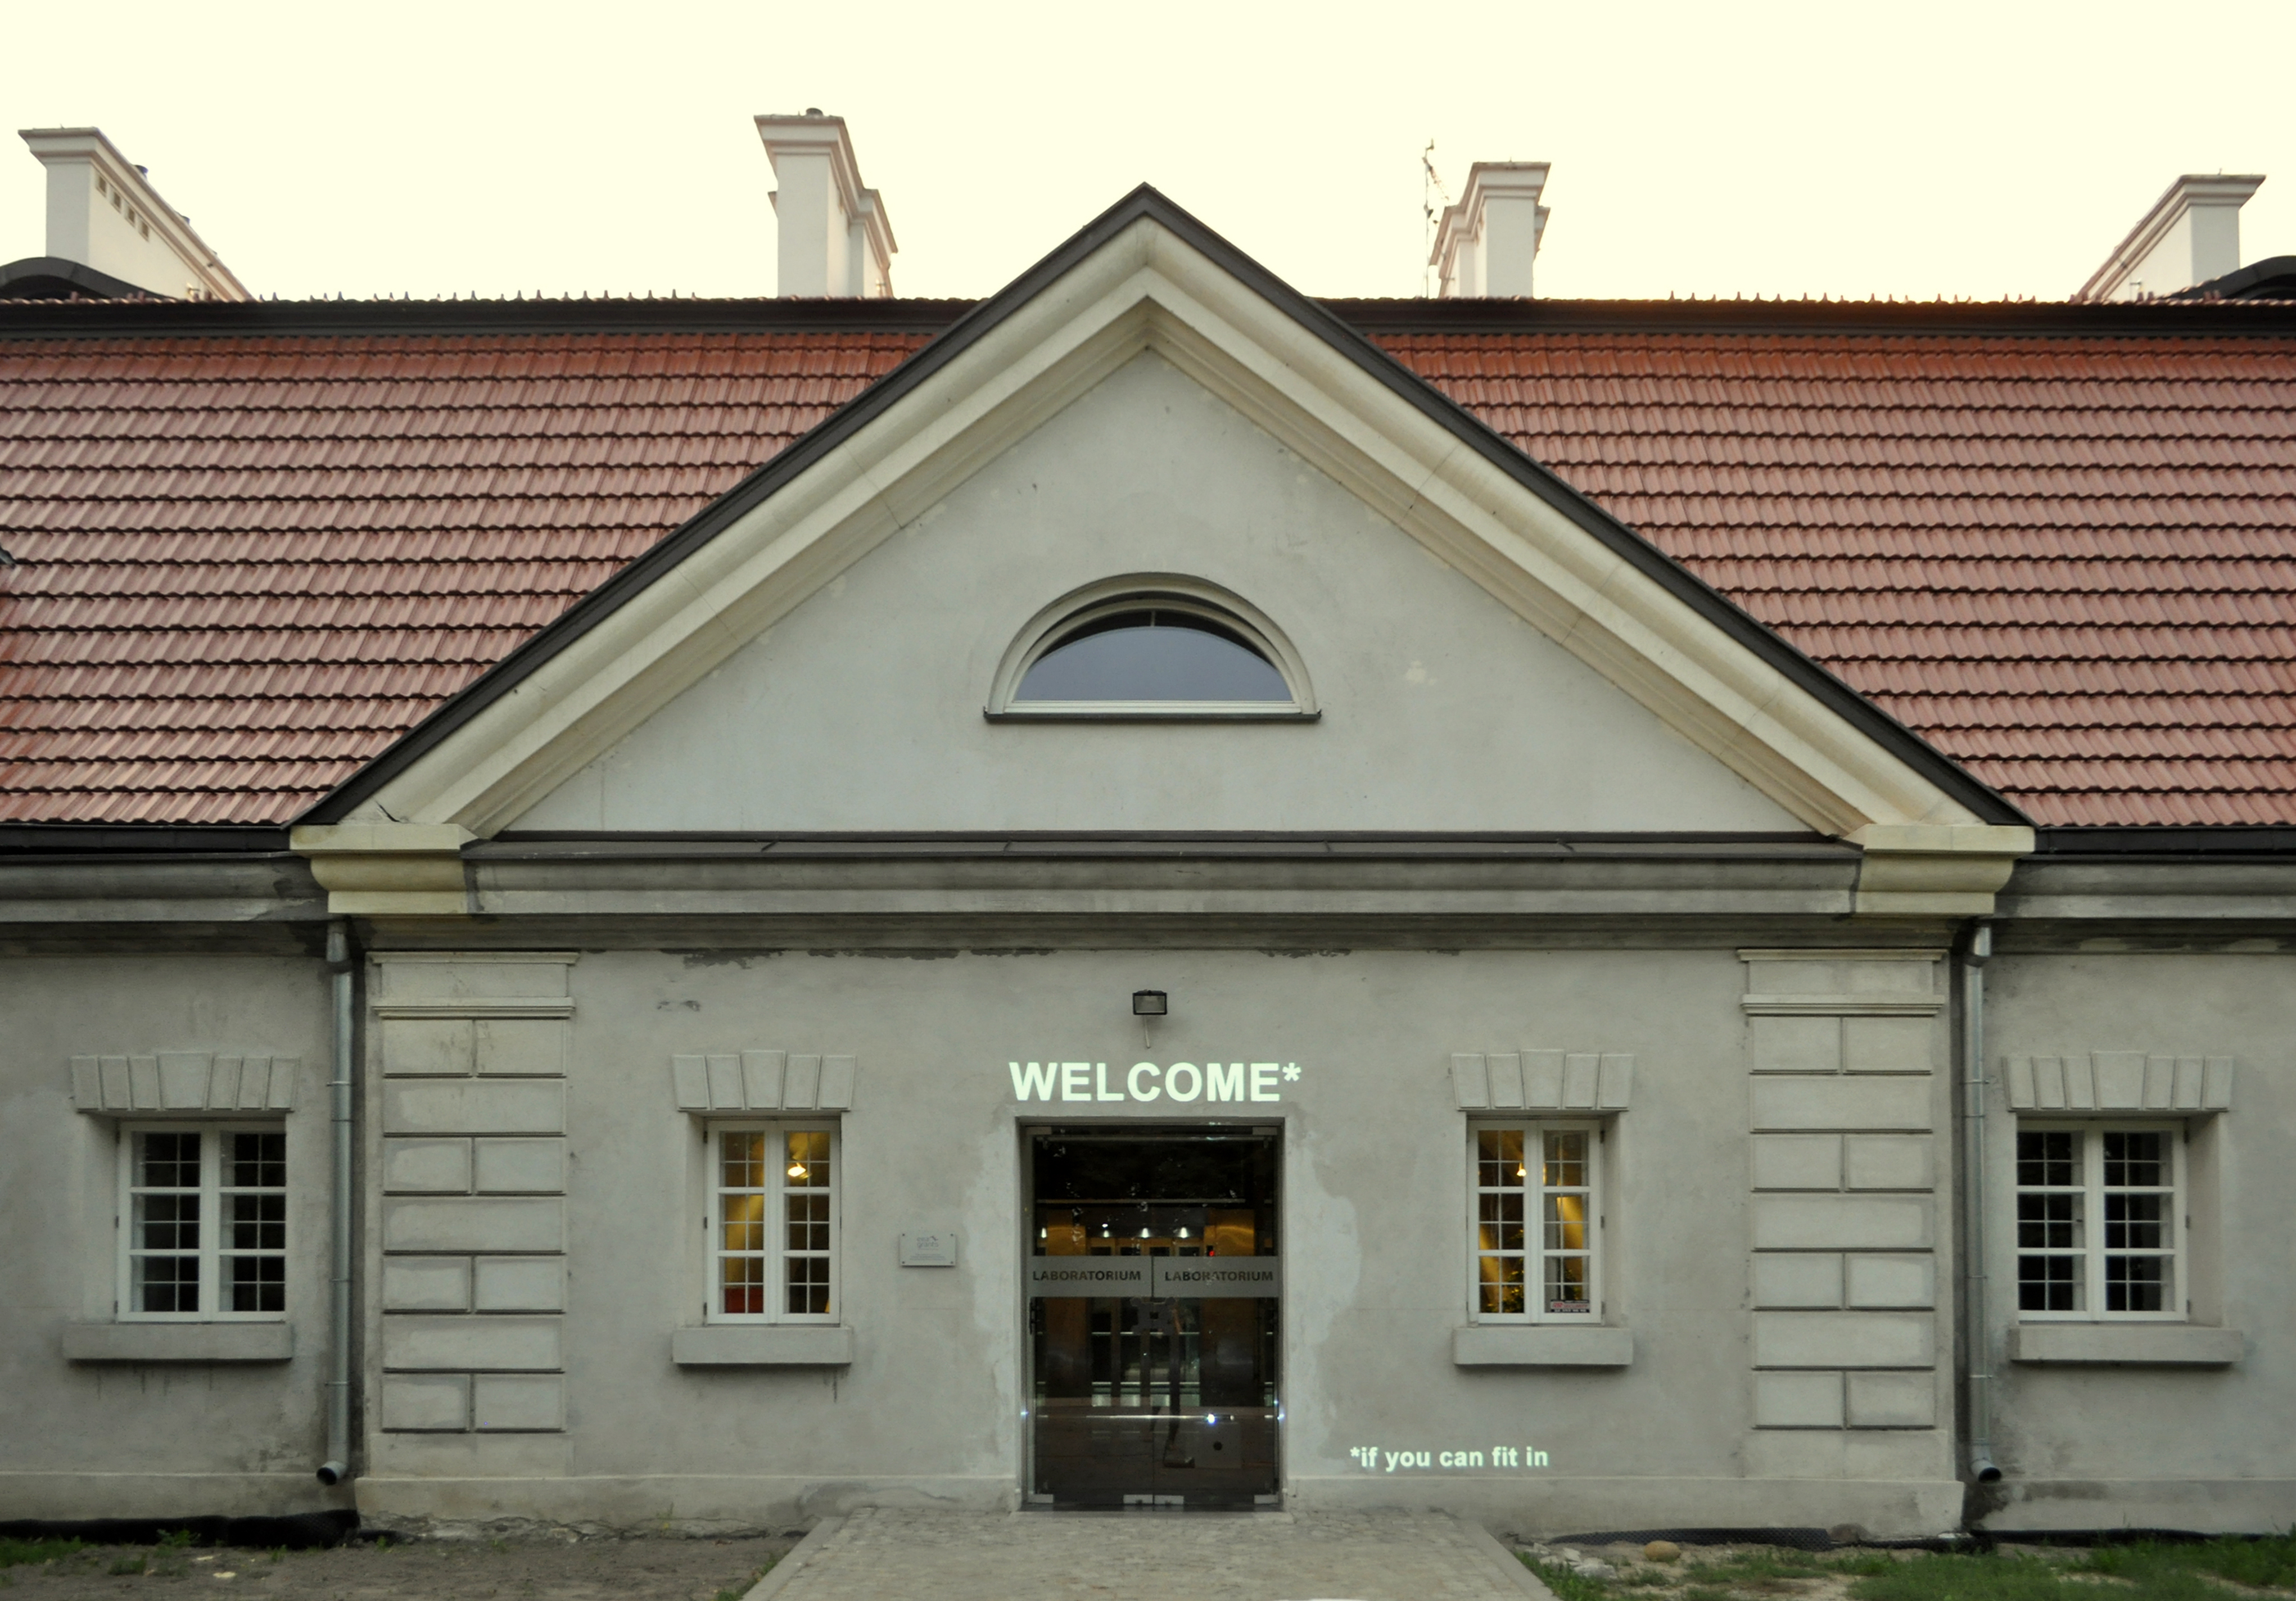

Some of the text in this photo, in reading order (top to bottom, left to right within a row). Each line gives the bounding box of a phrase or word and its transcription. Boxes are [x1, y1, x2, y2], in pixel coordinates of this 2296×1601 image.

[1033, 1270, 1142, 1281] LABORATORIUM
[1165, 1270, 1274, 1281] LABORATORIUM
[1384, 1451, 1431, 1472] you
[1439, 1451, 1484, 1468] can
[1492, 1446, 1518, 1467] fit
[1526, 1446, 1548, 1467] in
